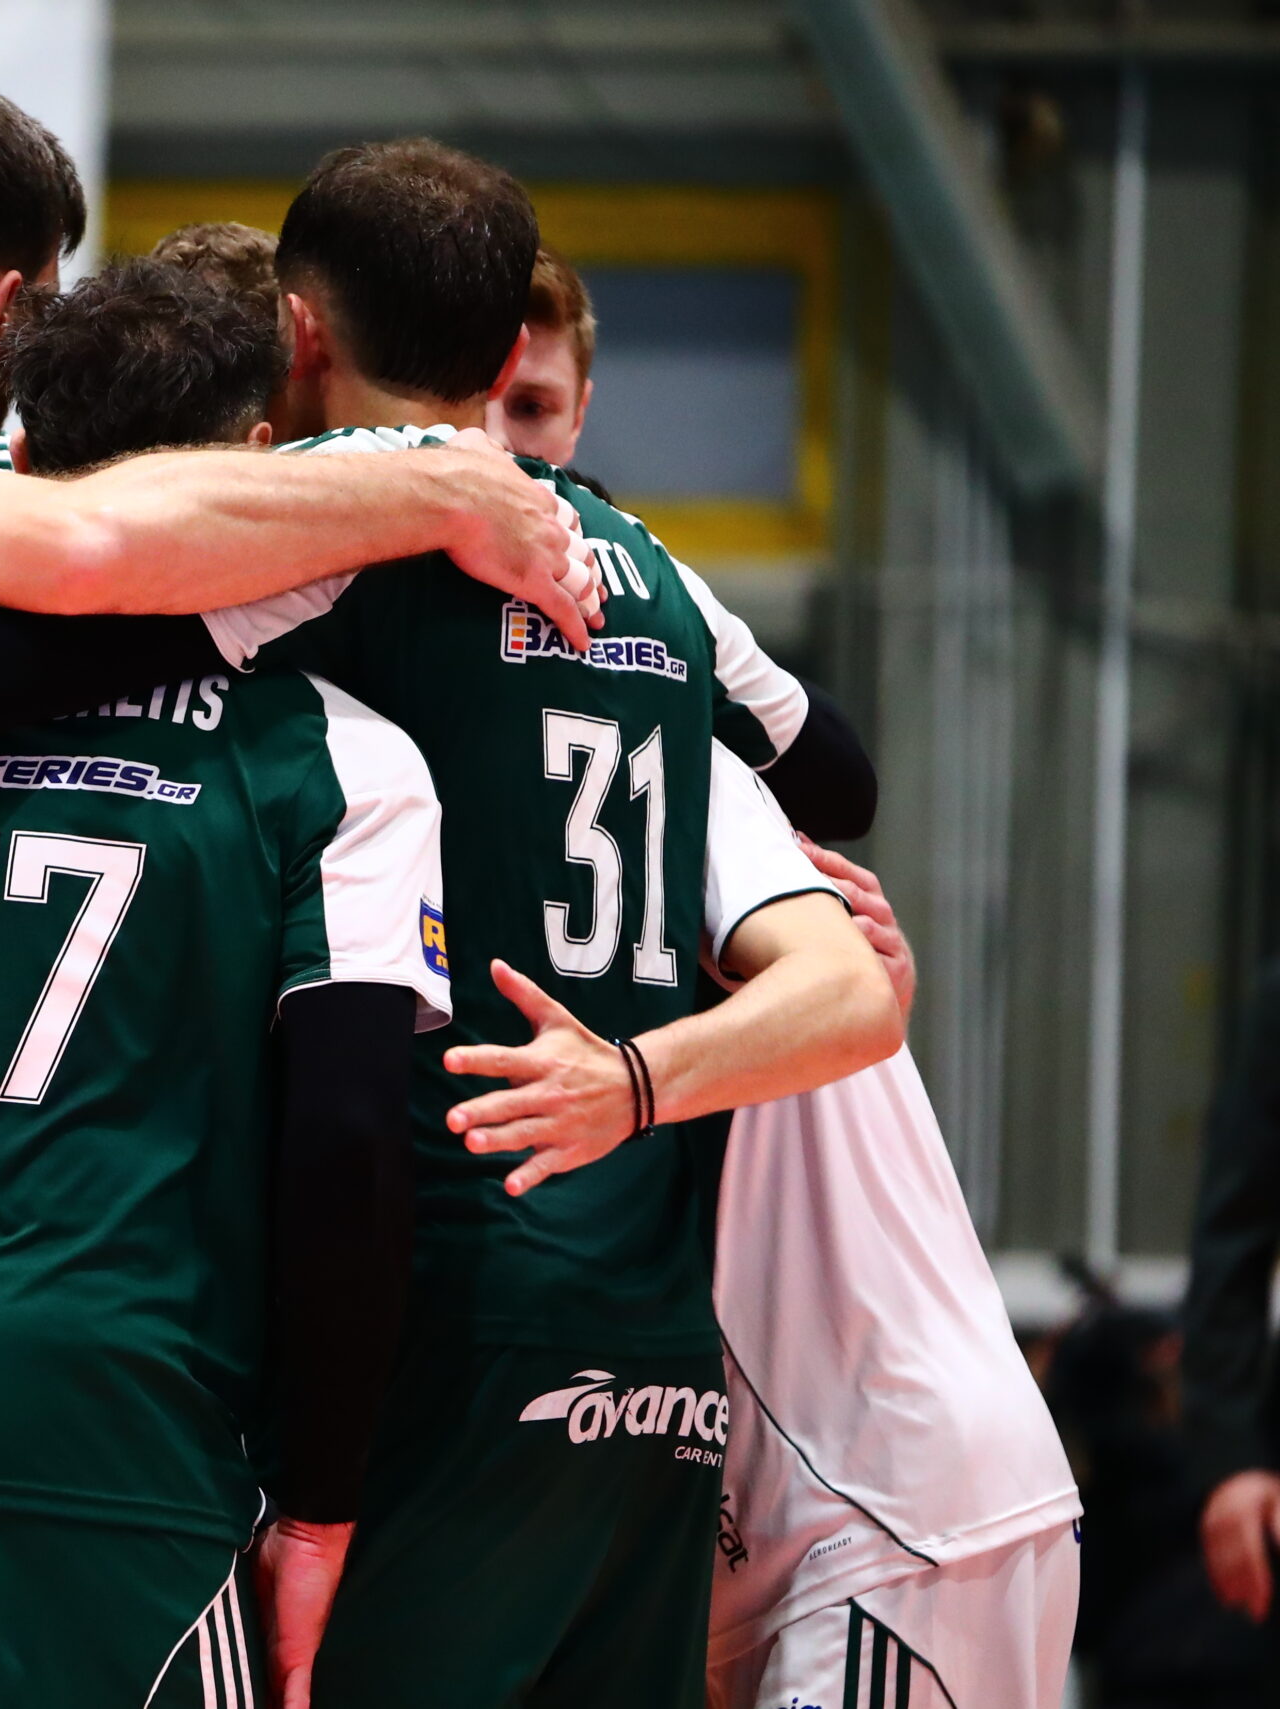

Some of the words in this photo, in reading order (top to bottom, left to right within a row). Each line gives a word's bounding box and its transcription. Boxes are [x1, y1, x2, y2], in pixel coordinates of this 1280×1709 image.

[523, 615, 687, 678] BAERIES.GR
[542, 708, 678, 988] 31
[674, 1445, 702, 1463] CAR
